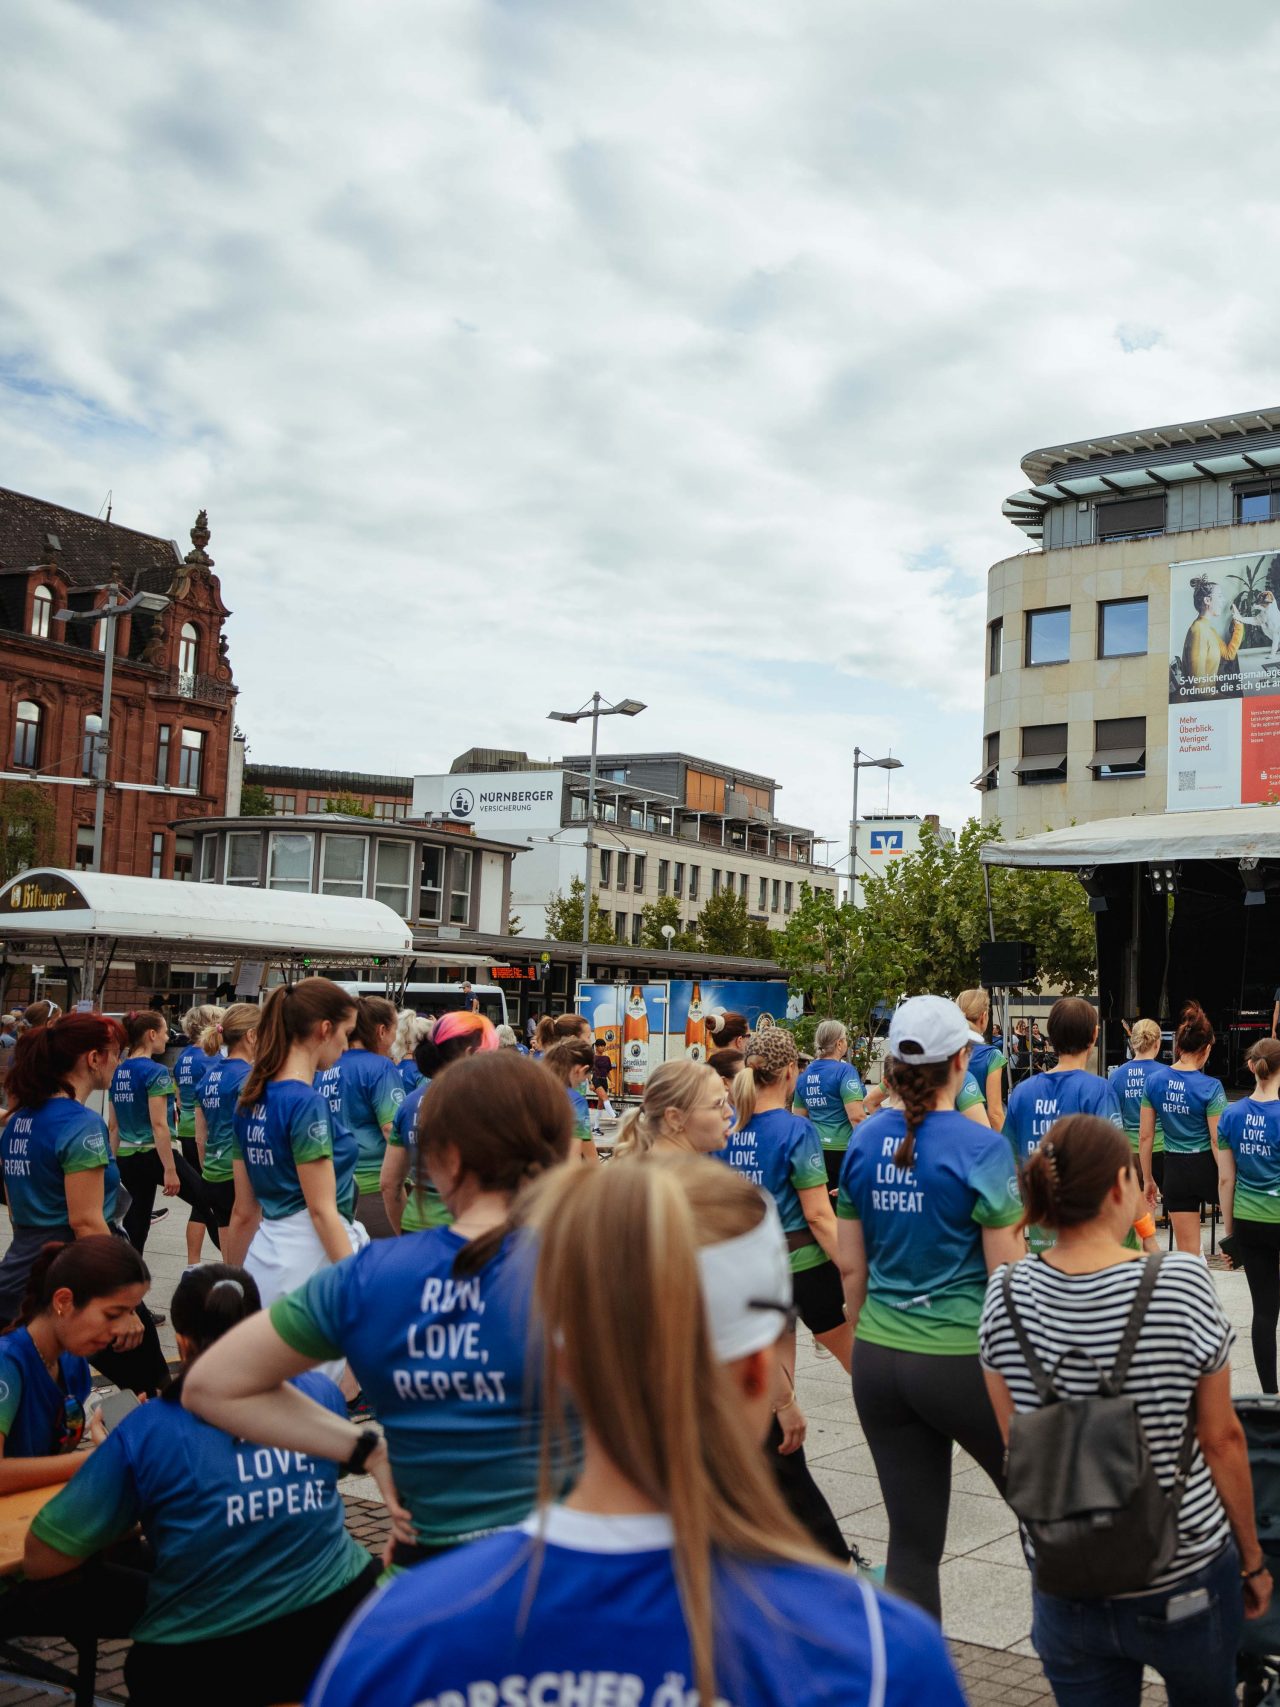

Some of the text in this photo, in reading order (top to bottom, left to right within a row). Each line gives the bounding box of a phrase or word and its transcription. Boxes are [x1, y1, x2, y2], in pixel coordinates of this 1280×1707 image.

[1220, 682, 1233, 692] die
[1236, 680, 1253, 690] sich
[1253, 680, 1270, 691] gut
[1179, 716, 1197, 724] Mehr
[1179, 724, 1214, 733] Überblick.
[1179, 735, 1208, 743] Weniger
[1179, 744, 1211, 752] Aufwand.
[480, 791, 554, 803] NÜRNBERGER
[480, 804, 532, 812] VERSICHERUNG
[22, 883, 68, 911] Bitburger
[117, 1069, 132, 1080] RUN,
[1128, 1068, 1145, 1077] RUN,
[115, 1082, 131, 1091] LOVE,
[1127, 1078, 1144, 1088] LOVE
[1168, 1080, 1186, 1092] RUN,
[1124, 1088, 1142, 1098] REPE
[1165, 1092, 1187, 1105] LOVE,
[1035, 1098, 1060, 1115] RUN,
[1162, 1103, 1190, 1115] REPEAT
[14, 1118, 33, 1135] RUN,
[1245, 1113, 1267, 1128] RUN,
[732, 1131, 758, 1147] RUN,
[1242, 1128, 1267, 1143] LOVE,
[9, 1139, 28, 1157] LOVE,
[1240, 1142, 1272, 1156] REPEAT
[729, 1150, 759, 1167] LOVE,
[4, 1159, 31, 1176] REPEAT
[876, 1163, 918, 1187] LOVE,
[871, 1190, 925, 1213] REPEAT
[420, 1276, 486, 1315] RUN,
[406, 1322, 489, 1364] LOVE,
[393, 1370, 506, 1404] REPEAT
[236, 1447, 316, 1483] LOVE,
[226, 1480, 326, 1527] REPEAT
